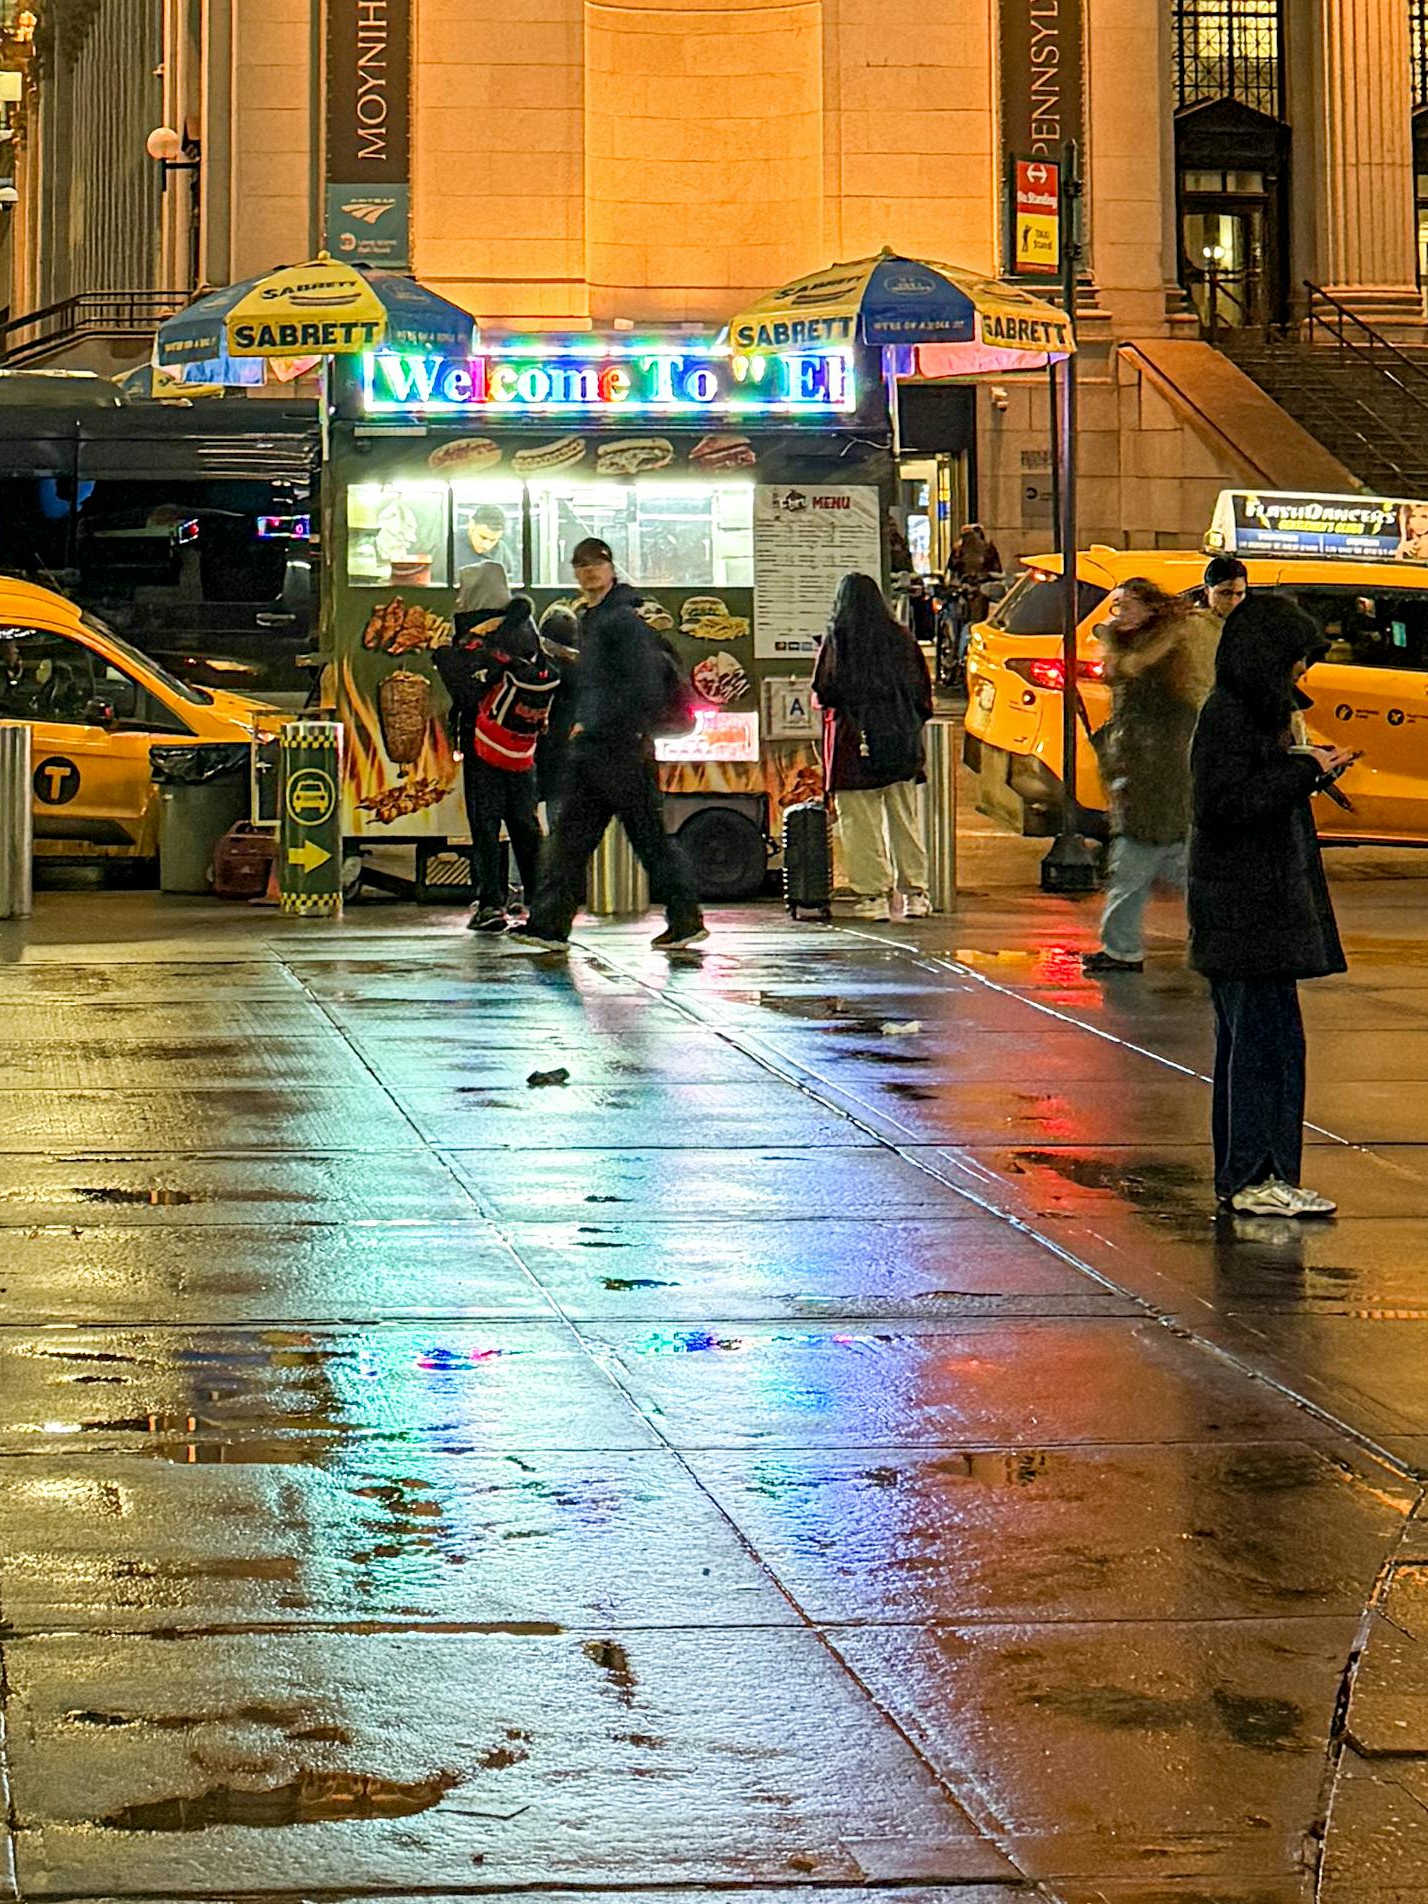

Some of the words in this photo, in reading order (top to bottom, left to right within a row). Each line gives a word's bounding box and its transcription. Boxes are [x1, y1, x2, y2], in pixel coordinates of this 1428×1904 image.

[261, 279, 359, 300] SABRETT
[234, 321, 381, 349] SABRETT
[737, 316, 855, 348] SABRETT
[983, 314, 1068, 345] SABRETT
[376, 354, 631, 403] Welcome
[643, 355, 719, 403] To
[812, 496, 851, 510] MENU
[789, 697, 805, 716] A
[44, 765, 71, 800] T
